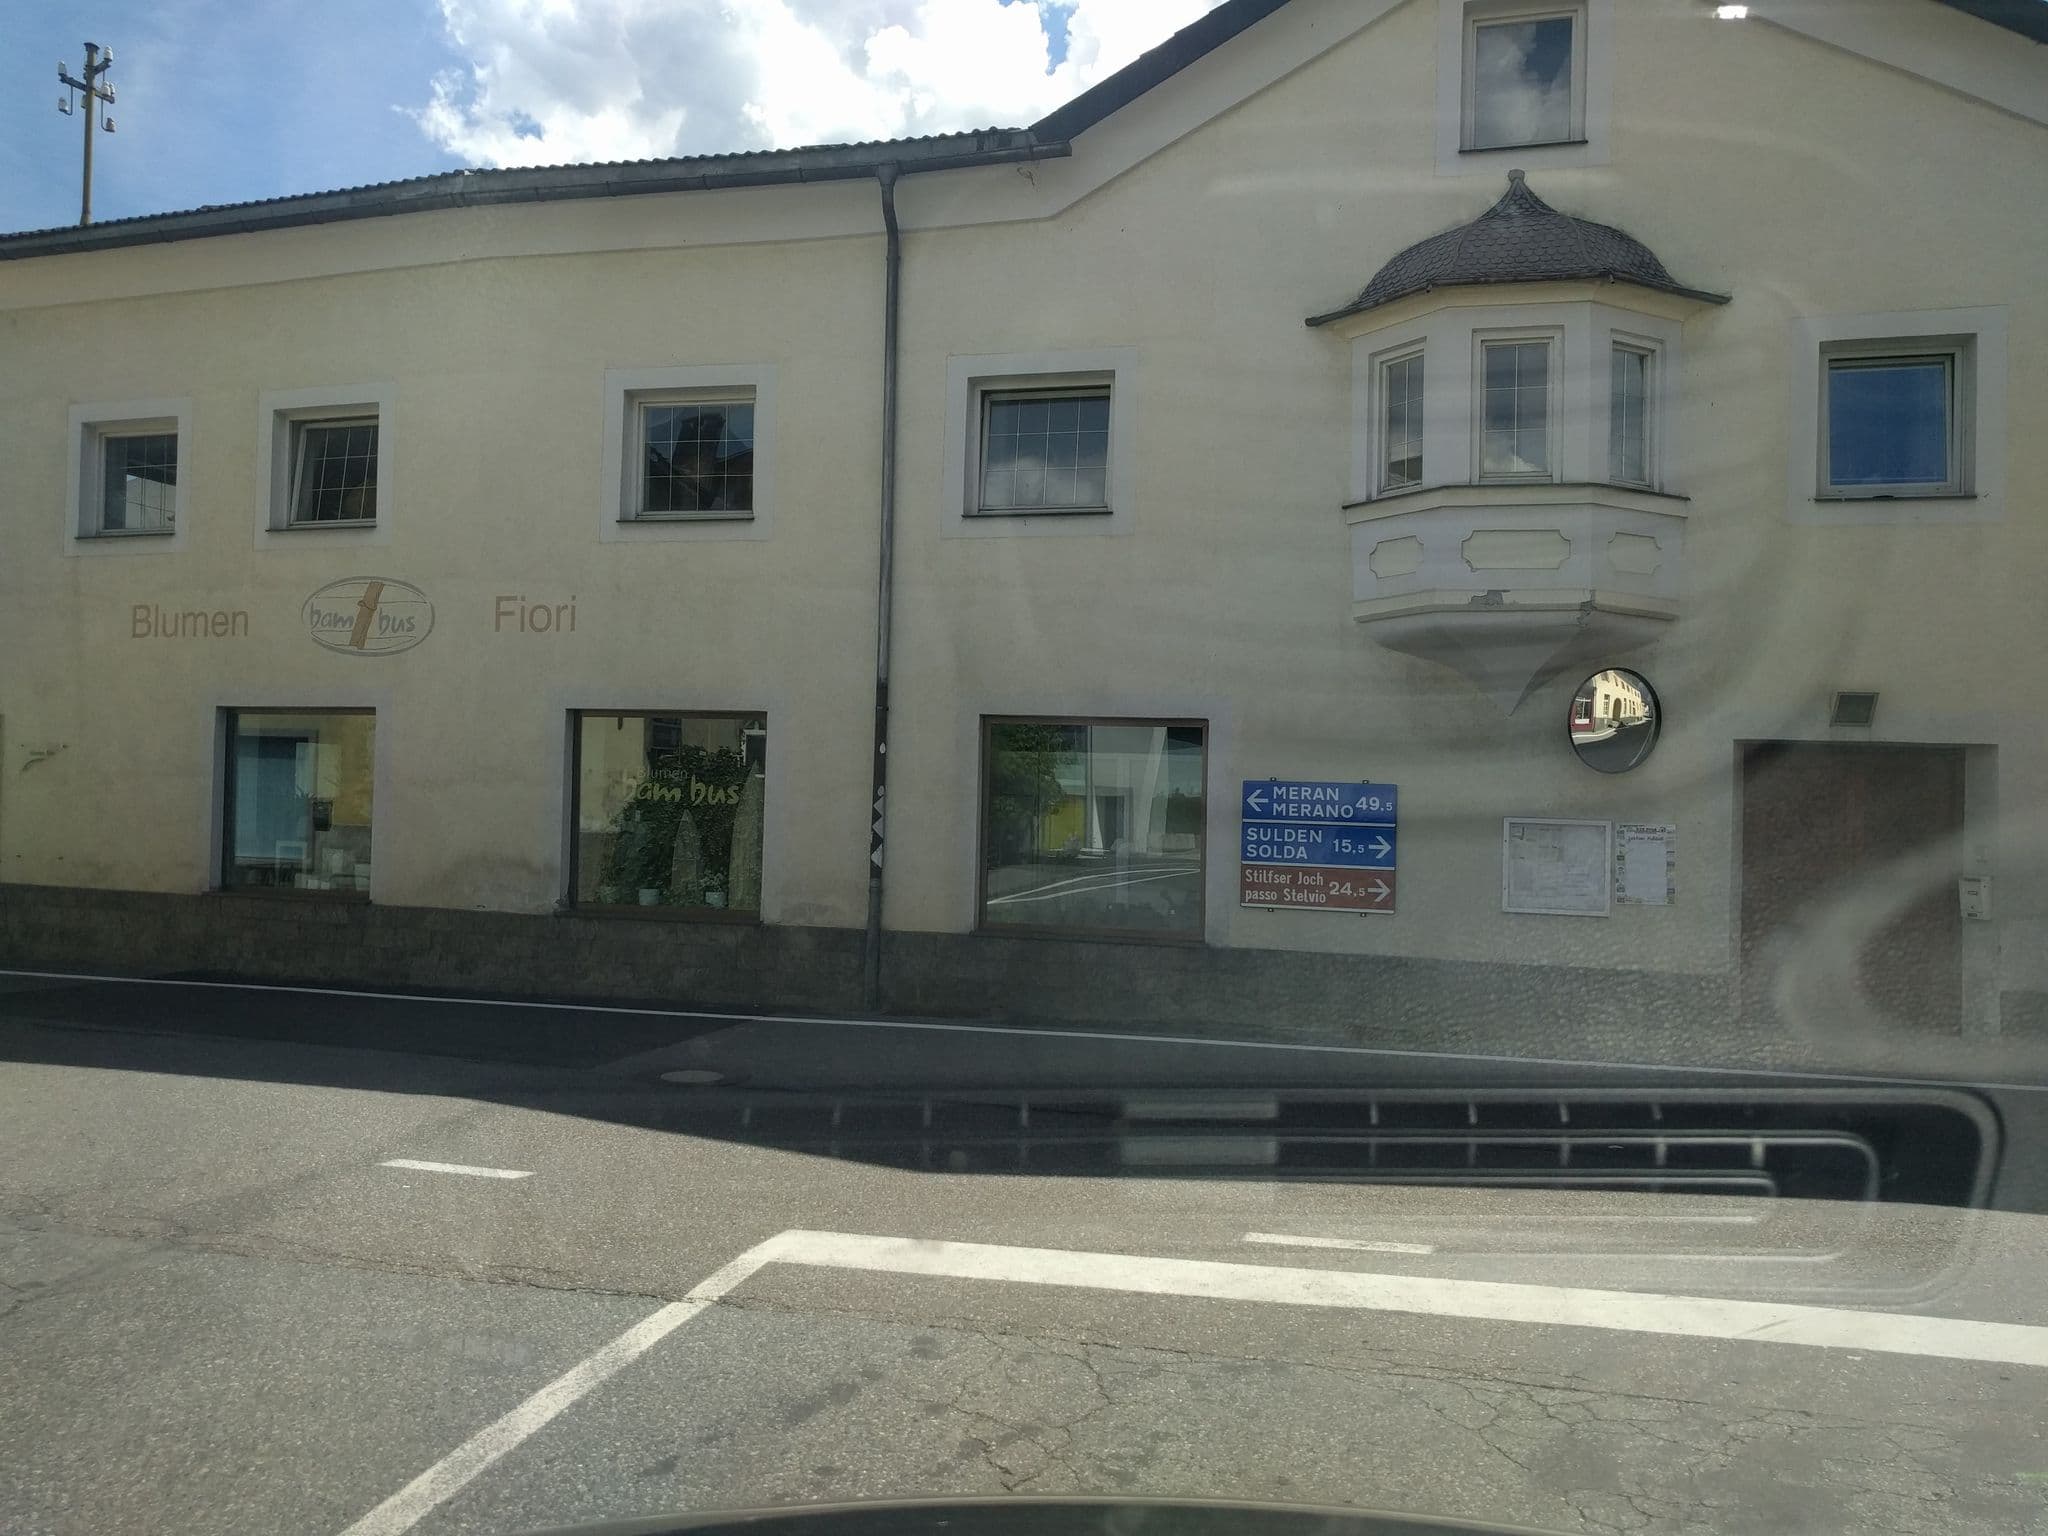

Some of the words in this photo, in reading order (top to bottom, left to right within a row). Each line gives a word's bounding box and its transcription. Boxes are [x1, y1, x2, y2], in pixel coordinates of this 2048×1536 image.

[131, 604, 249, 639] Blumen
[378, 607, 416, 636] bus
[494, 595, 577, 633] Fiori
[690, 774, 739, 806] bus
[1272, 786, 1339, 801] MERAN
[1272, 803, 1354, 818] MERANO
[1246, 827, 1323, 843] SULDEN
[1246, 844, 1308, 860] SOLDA
[1245, 869, 1292, 885] Stilfser
[1297, 872, 1324, 887] Joch
[1245, 889, 1278, 903] passo
[1283, 888, 1327, 904] Stelvio
